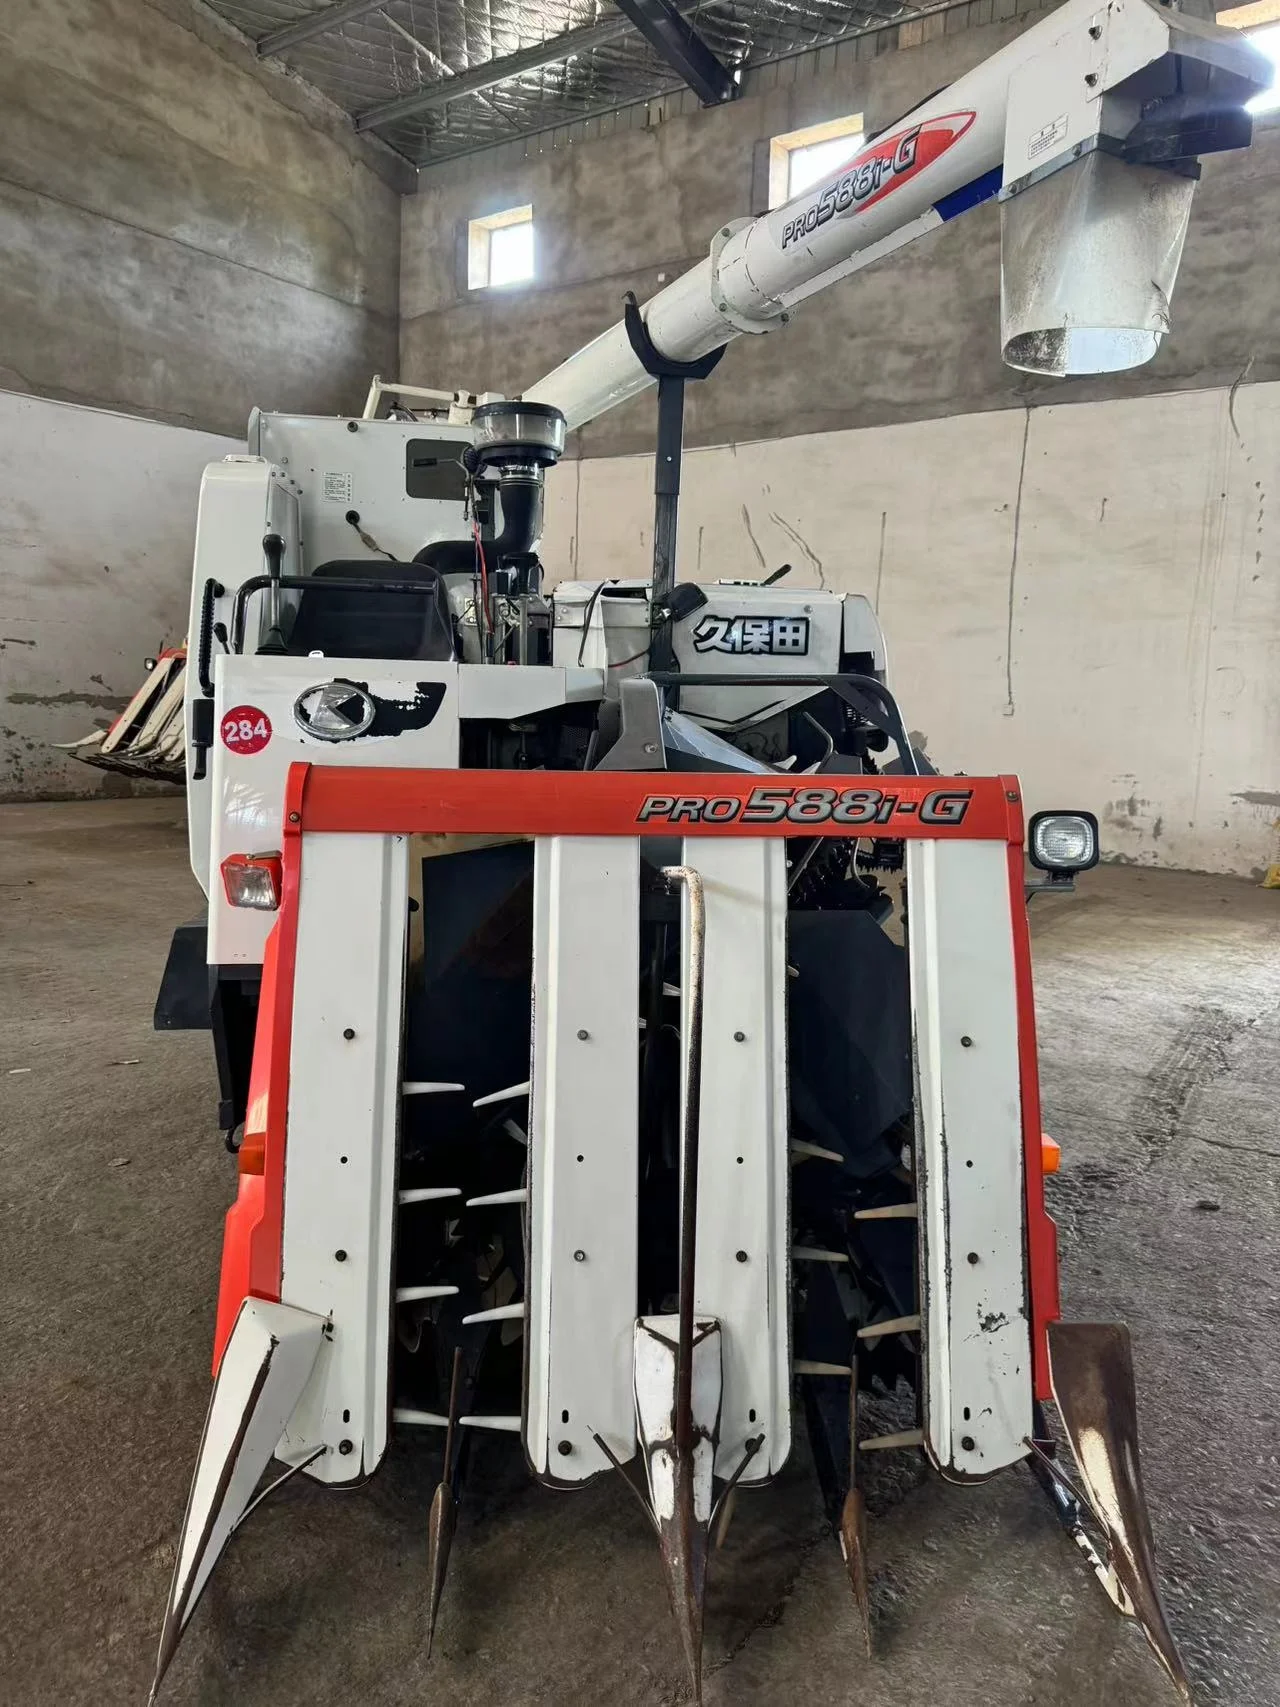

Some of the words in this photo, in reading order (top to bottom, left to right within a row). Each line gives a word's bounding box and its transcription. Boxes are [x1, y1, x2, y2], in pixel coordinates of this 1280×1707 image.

[693, 615, 809, 655] 久保田
[224, 719, 268, 743] 284
